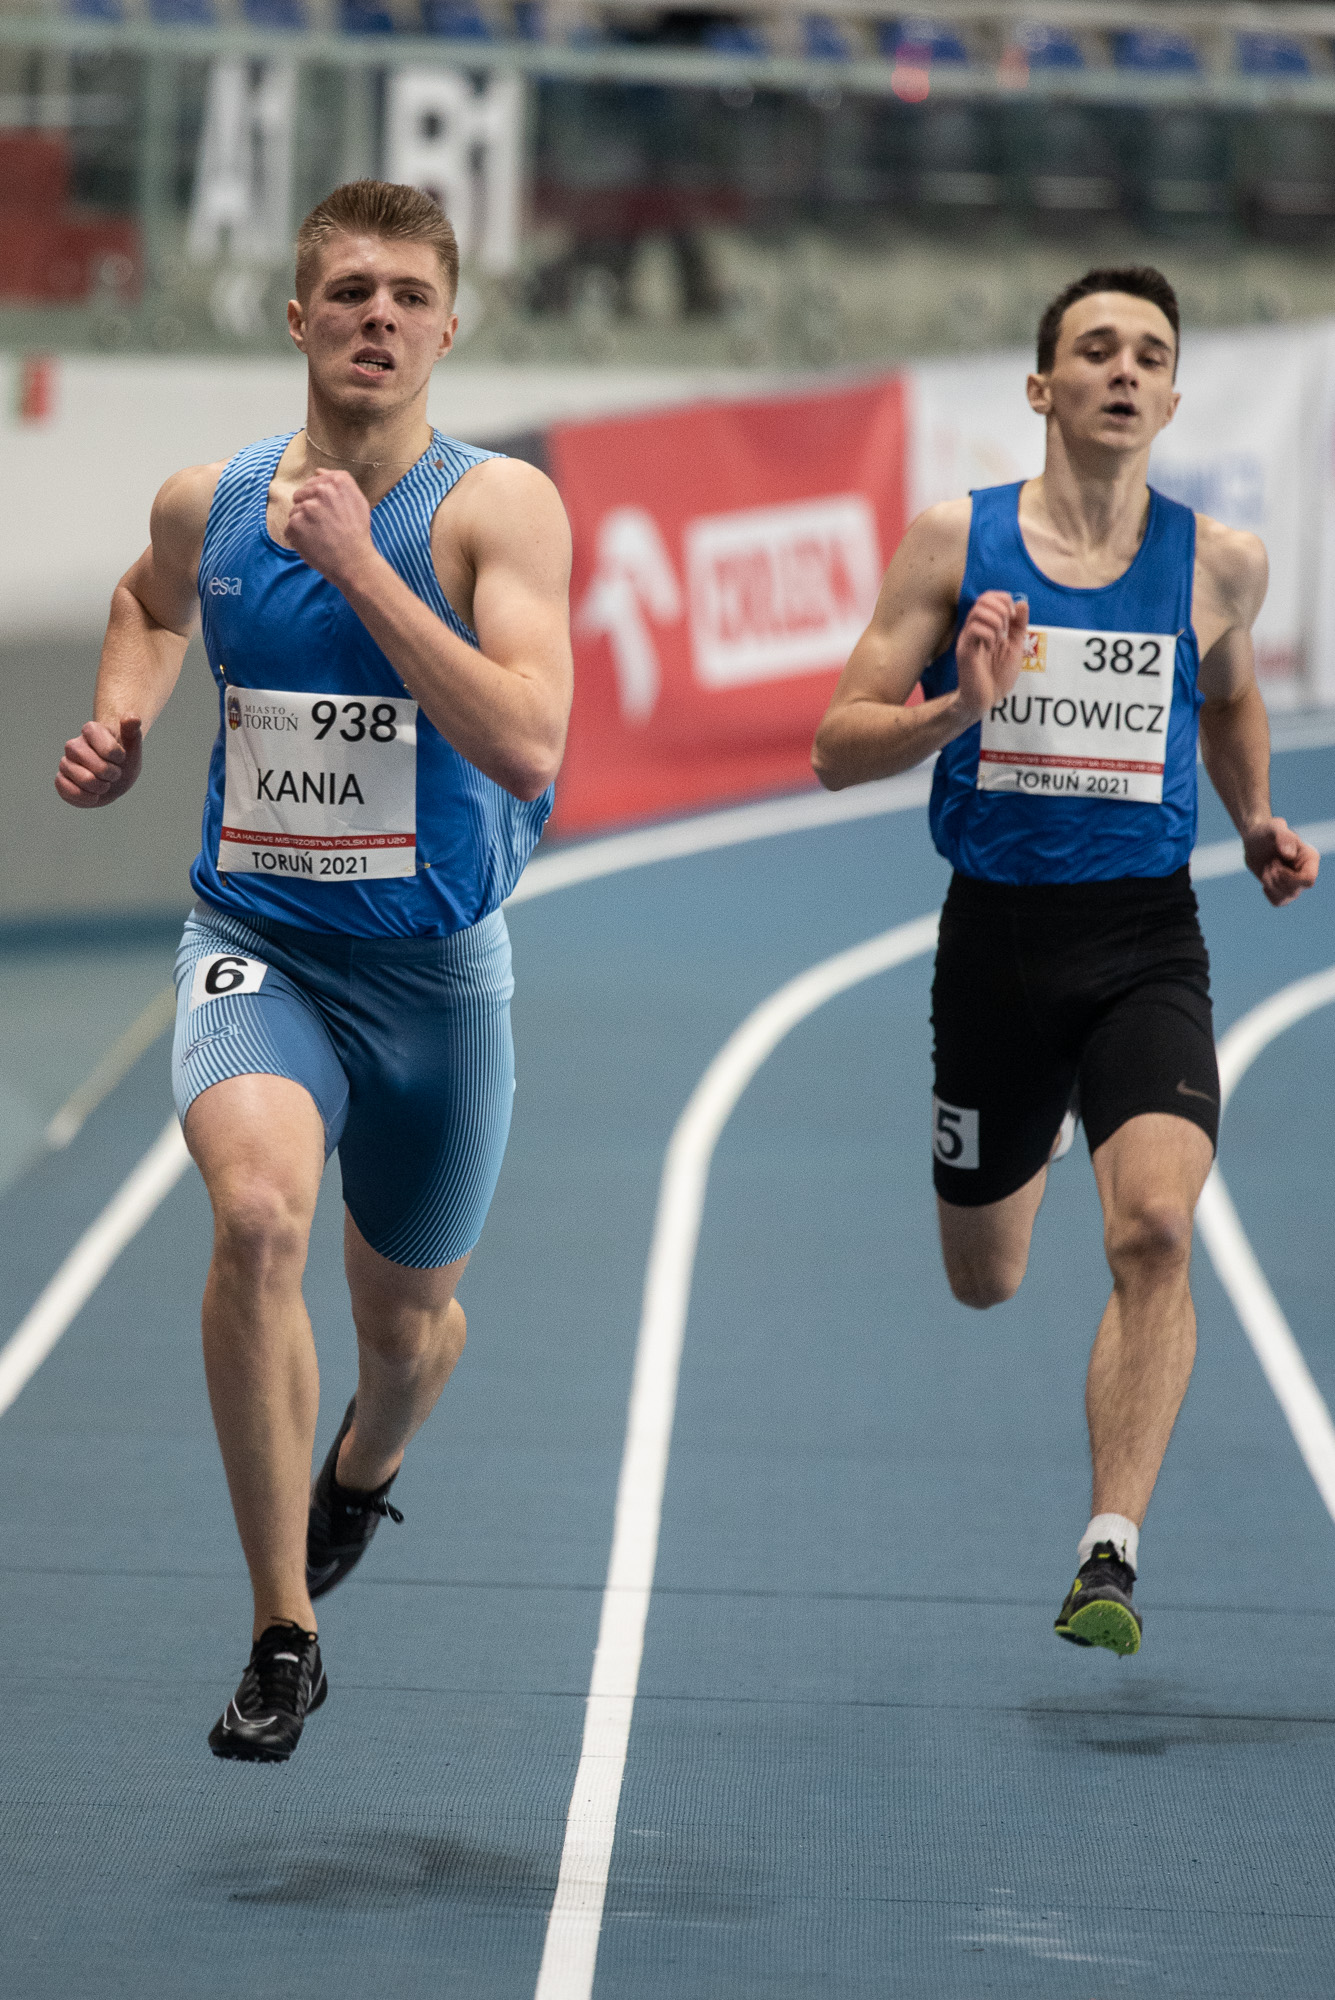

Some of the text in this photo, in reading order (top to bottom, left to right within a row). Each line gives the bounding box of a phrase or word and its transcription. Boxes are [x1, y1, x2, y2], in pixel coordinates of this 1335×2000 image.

[209, 577, 242, 595] esa
[1083, 637, 1161, 676] 382
[244, 713, 299, 731] TORUŃ
[245, 705, 286, 715] MIASTO
[311, 700, 397, 743] 938
[990, 695, 1164, 733] RUTOWICZ
[257, 767, 365, 805] KANIA
[1016, 769, 1129, 795] TORUŃ 2021
[387, 837, 407, 845] U20
[252, 851, 367, 875] TORUŃ 2021
[205, 957, 248, 995] 6
[937, 1107, 963, 1161] 5
